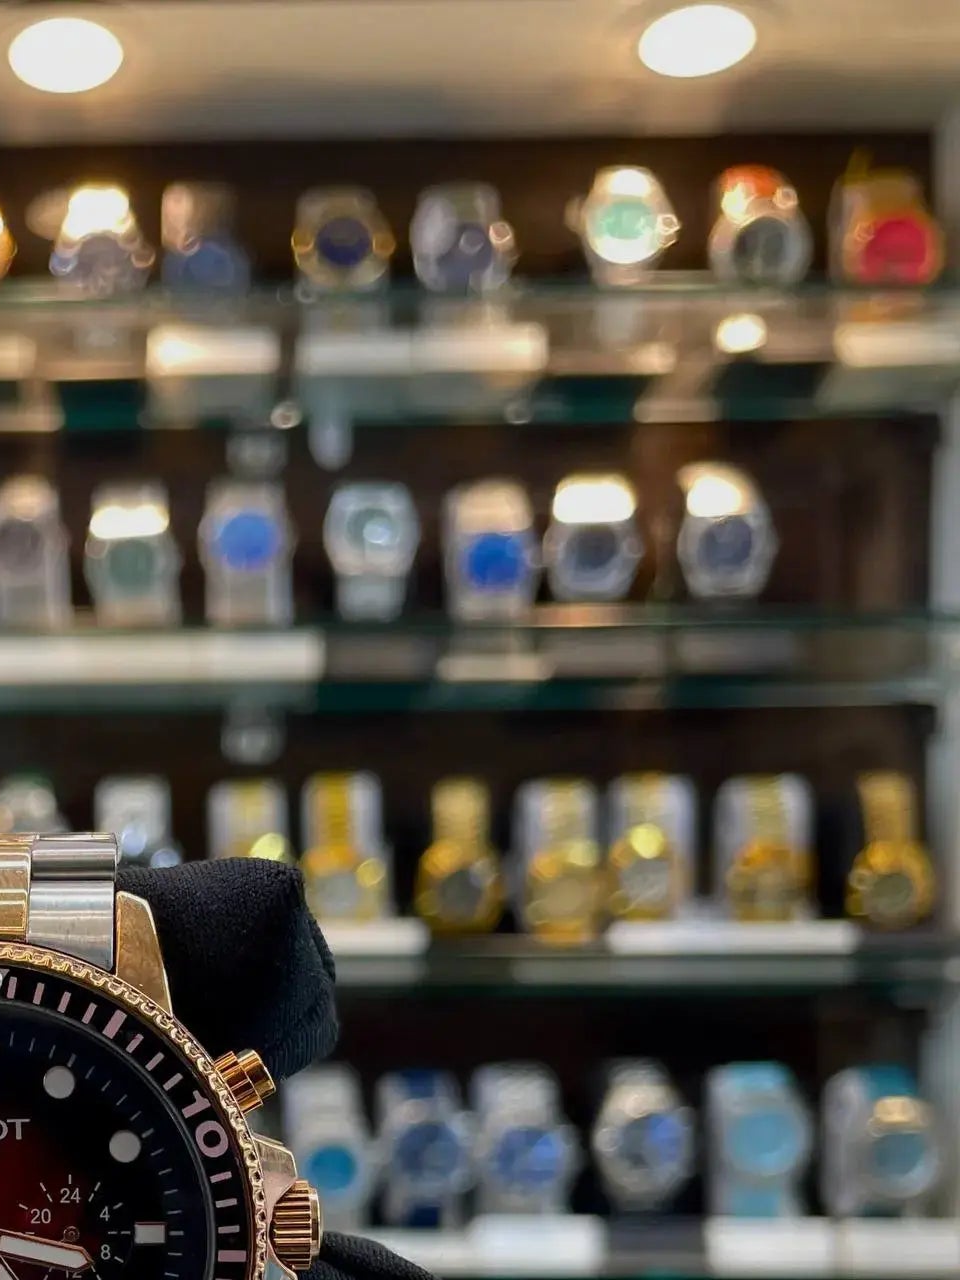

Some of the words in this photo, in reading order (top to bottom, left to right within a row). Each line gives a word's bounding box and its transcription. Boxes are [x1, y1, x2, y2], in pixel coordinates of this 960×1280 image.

[180, 1090, 230, 1159] 10
[60, 1188, 81, 1203] 24
[30, 1208, 51, 1224] 20
[99, 1207, 111, 1221] 4
[100, 1245, 111, 1260] 8
